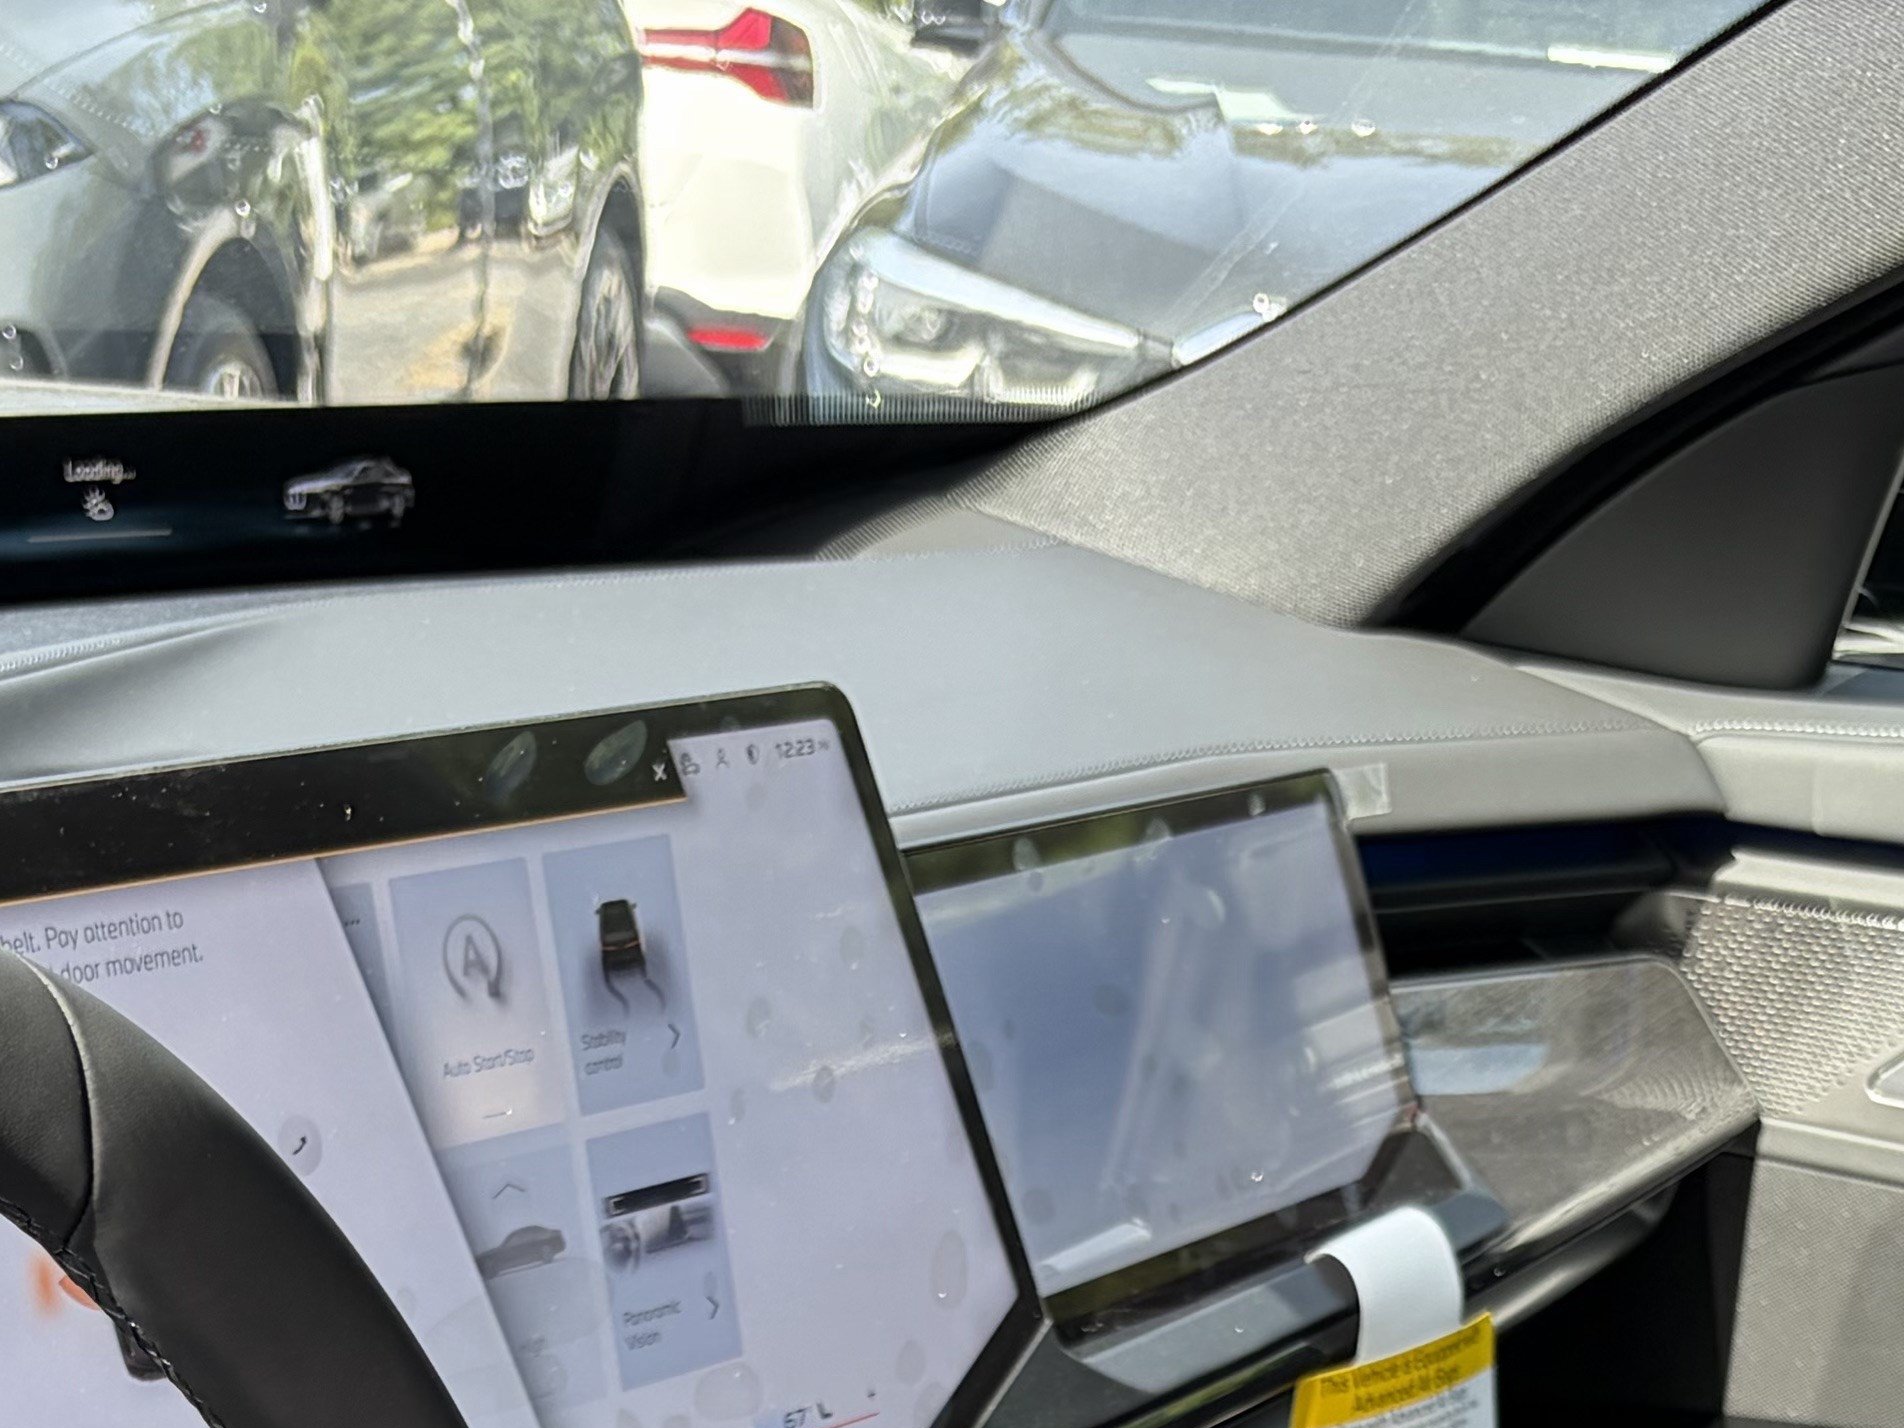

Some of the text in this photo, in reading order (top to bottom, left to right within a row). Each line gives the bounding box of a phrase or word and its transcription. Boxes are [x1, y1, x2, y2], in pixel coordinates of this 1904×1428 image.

[45, 926, 80, 952] Pay
[83, 911, 163, 942] attention
[166, 909, 184, 931] to
[61, 943, 204, 986] door movement.
